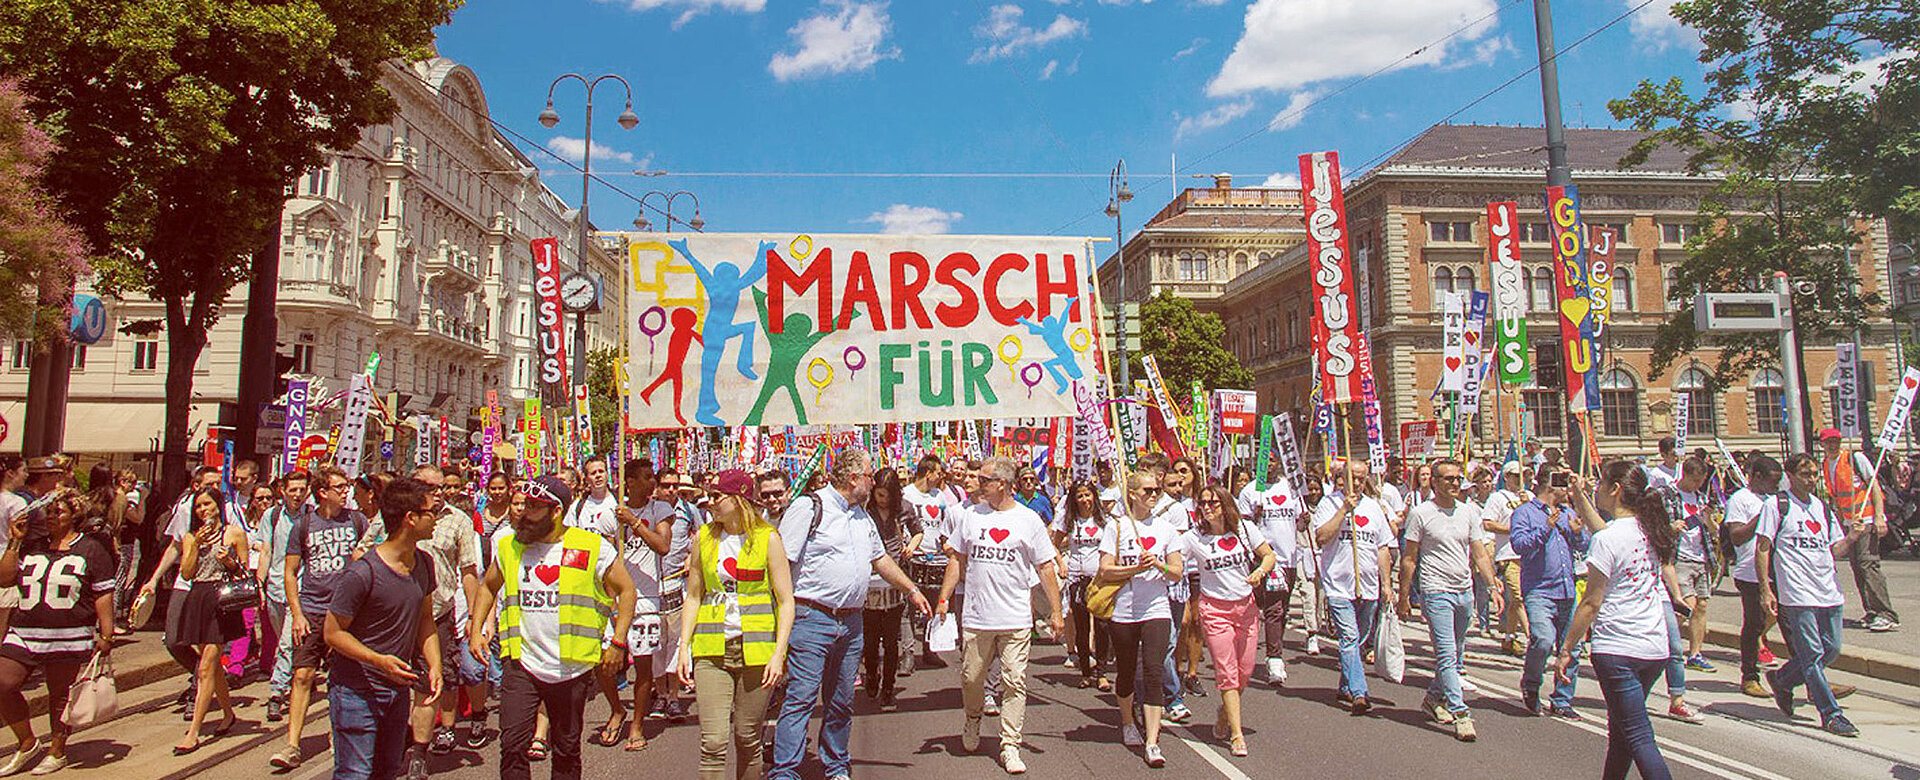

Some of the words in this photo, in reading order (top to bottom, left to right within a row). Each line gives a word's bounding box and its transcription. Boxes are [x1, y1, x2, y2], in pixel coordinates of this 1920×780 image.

[1554, 197, 1582, 287] GOD
[766, 247, 1082, 333] MARSCH
[1492, 204, 1524, 374] JESUS
[879, 340, 1000, 410] FÜR
[1464, 354, 1479, 406] DICH
[1569, 338, 1591, 373] U
[1840, 351, 1855, 427] JESUS
[287, 388, 305, 464] GNADE
[526, 406, 538, 473] JESUS
[1119, 403, 1137, 465] JESUS
[1882, 395, 1909, 442] DICH
[482, 435, 493, 485] JESUS
[307, 527, 356, 547] JESUS
[1263, 508, 1294, 518] JESUS
[1339, 530, 1375, 543] JESUS
[971, 544, 1016, 562] JESUS
[1788, 537, 1828, 549] JES
[18, 554, 87, 611] 36
[519, 589, 559, 607] ESU
